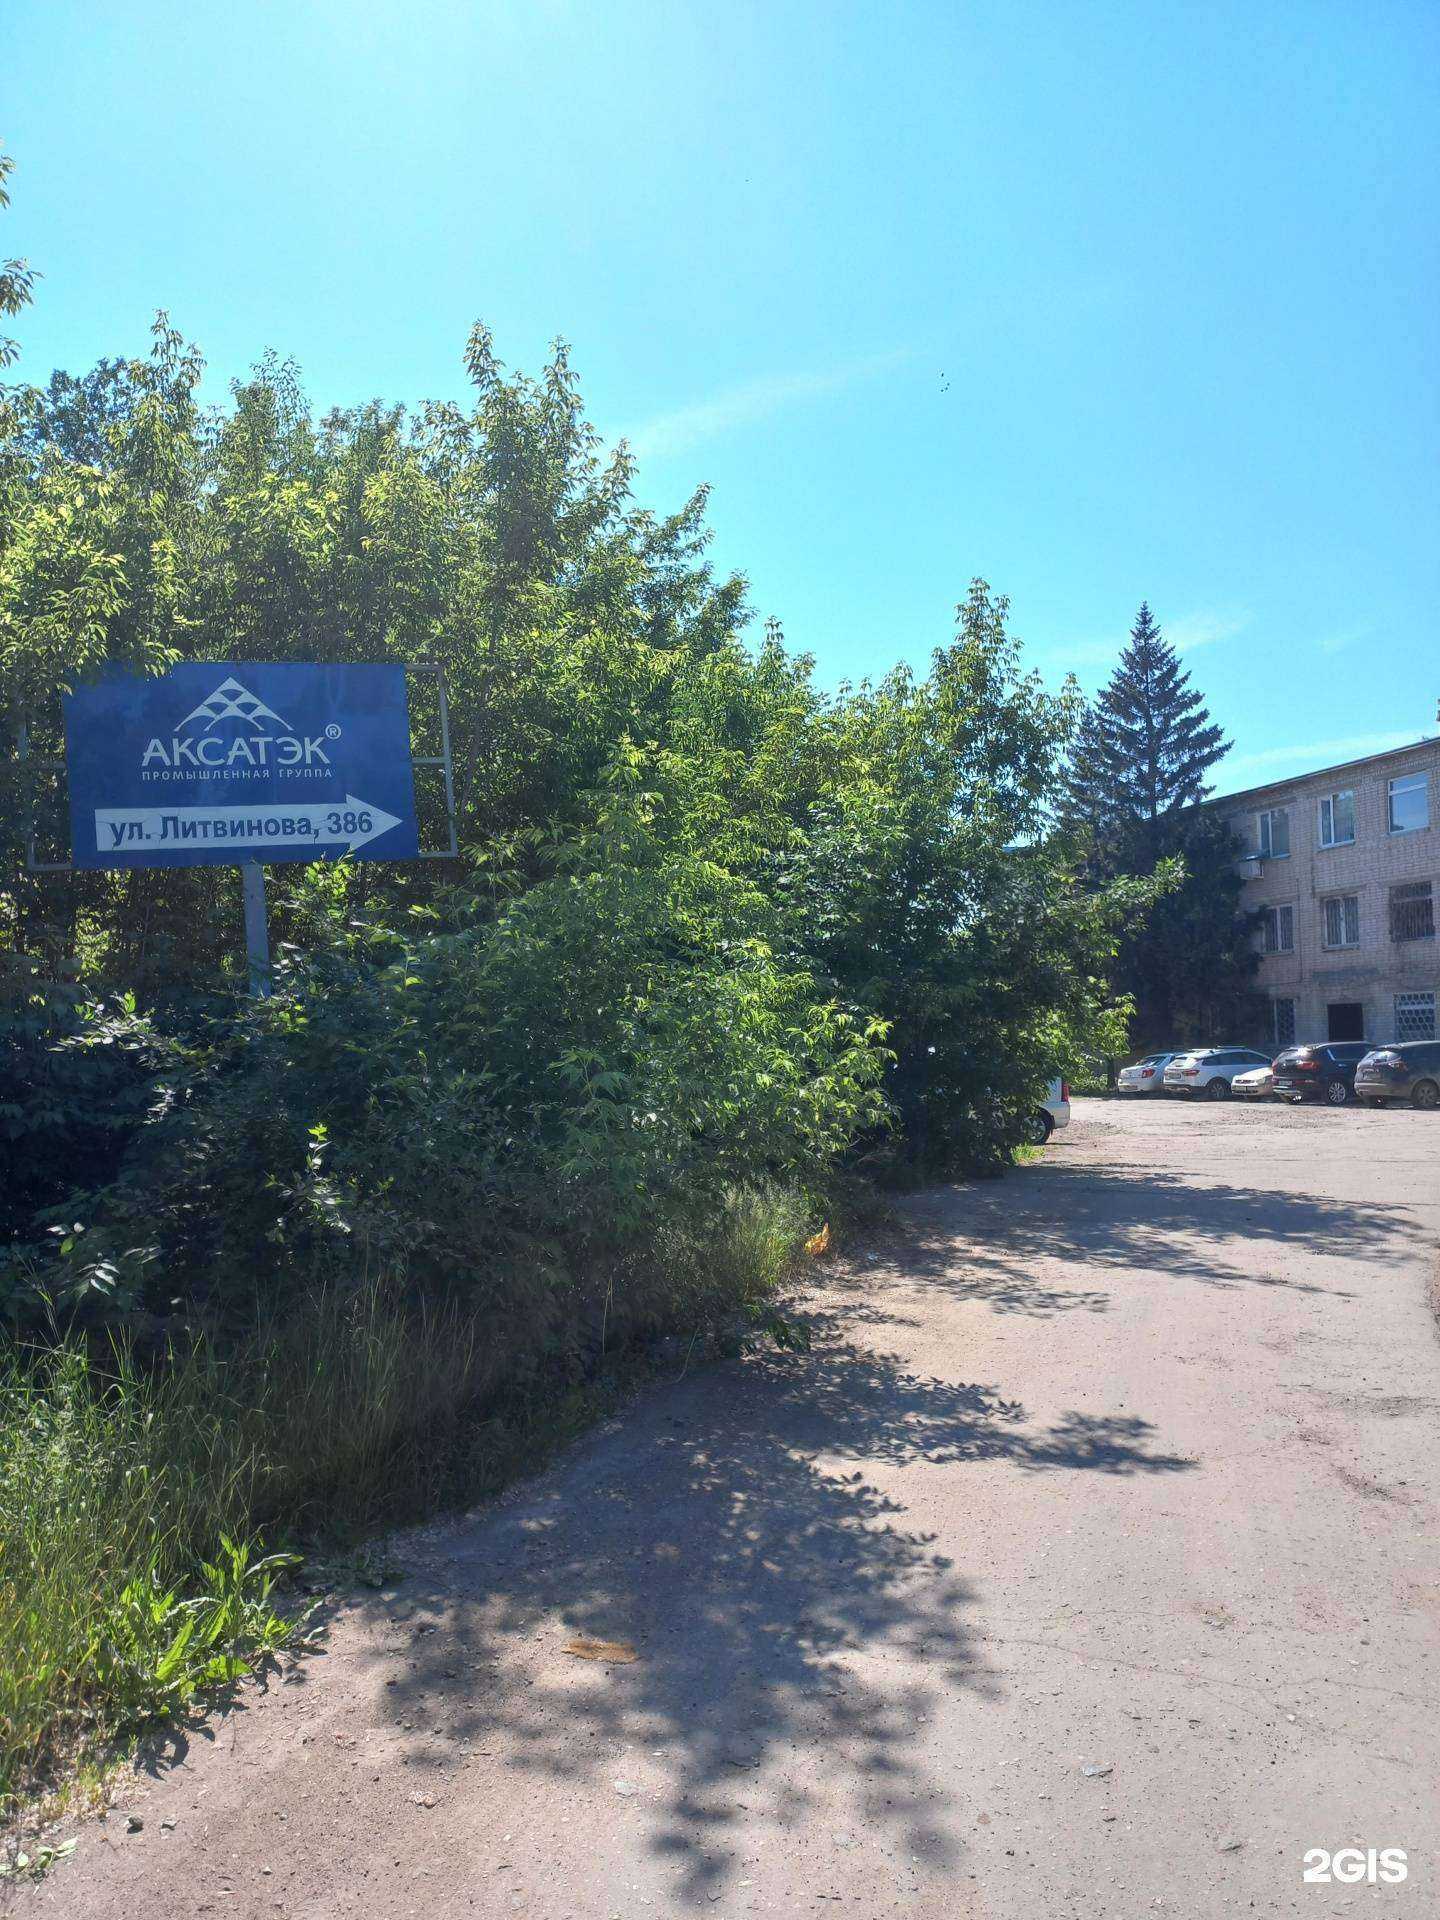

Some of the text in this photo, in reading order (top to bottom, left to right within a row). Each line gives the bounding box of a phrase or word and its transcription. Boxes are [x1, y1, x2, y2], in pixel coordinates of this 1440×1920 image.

[142, 768, 333, 781] ПРОМЫШЛЕННАЯ ГРУППА
[109, 811, 373, 847] ул. Литвинова, 386
